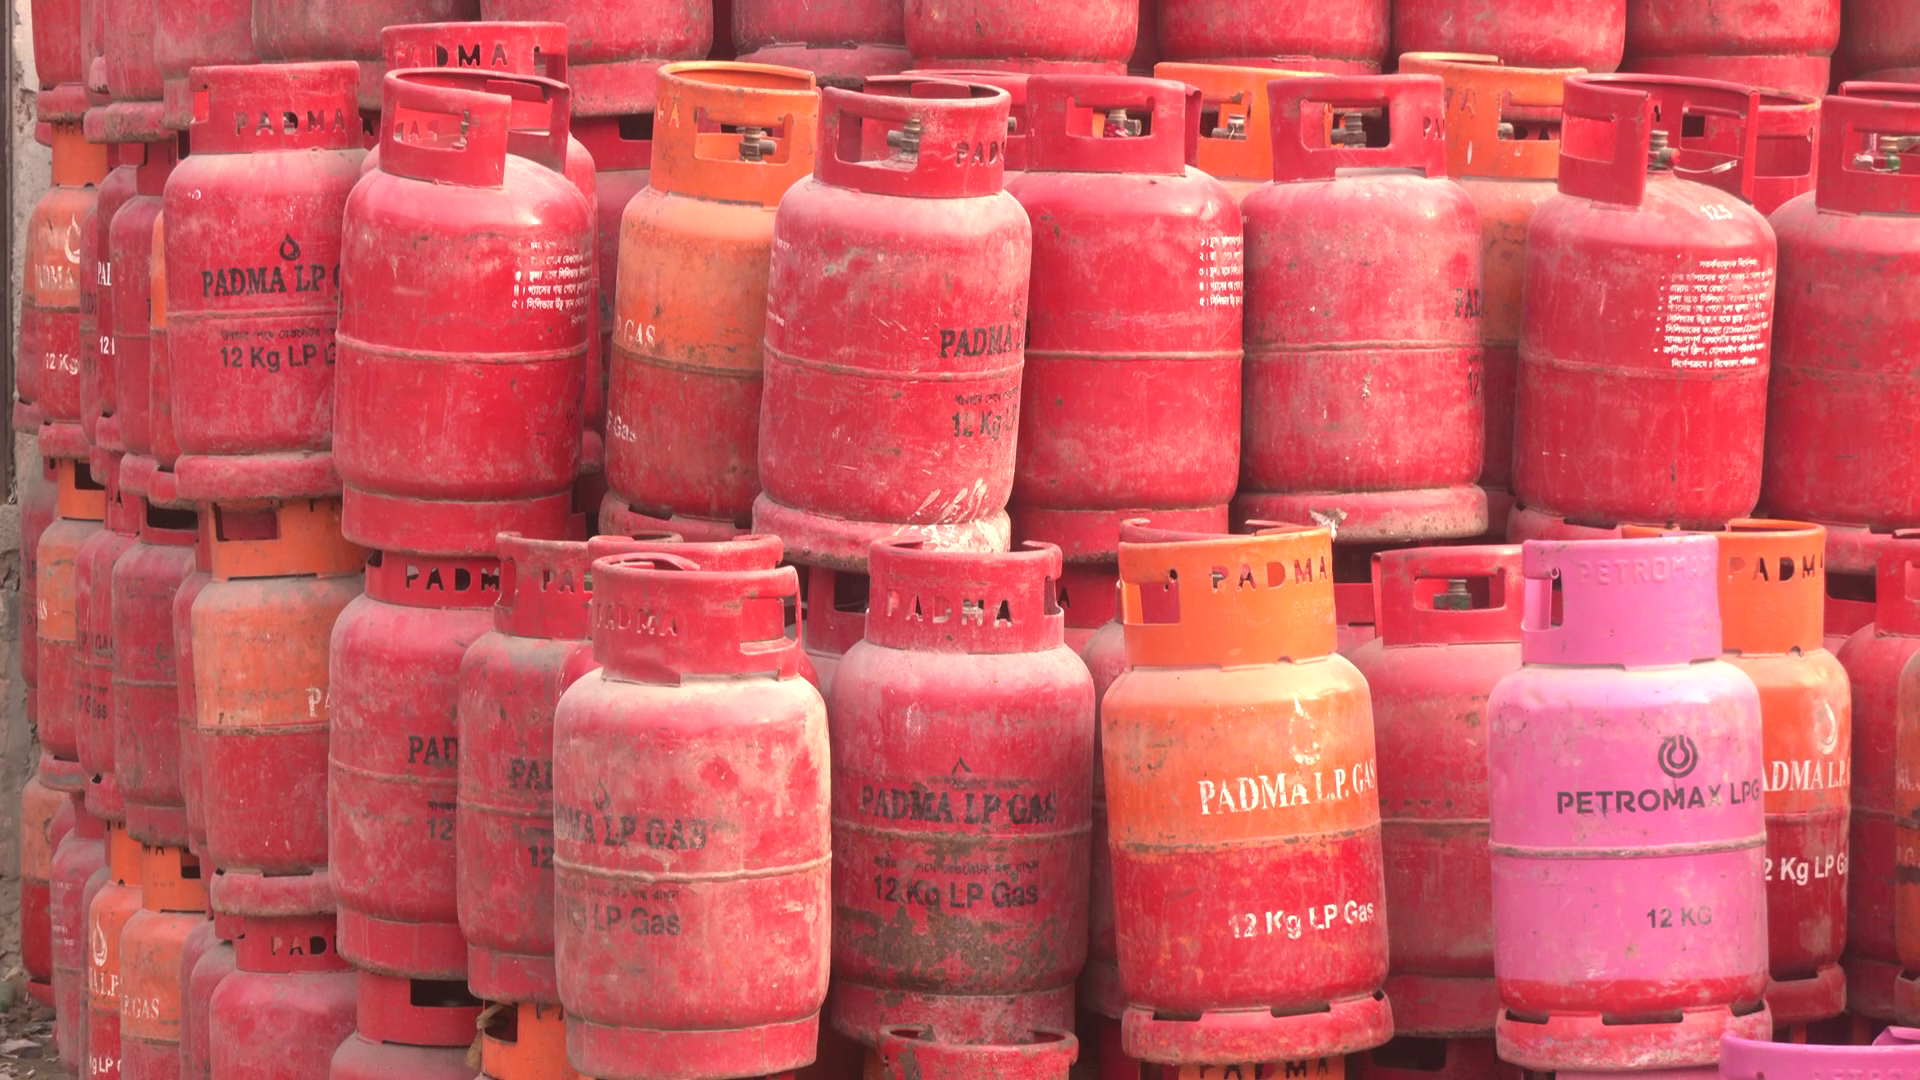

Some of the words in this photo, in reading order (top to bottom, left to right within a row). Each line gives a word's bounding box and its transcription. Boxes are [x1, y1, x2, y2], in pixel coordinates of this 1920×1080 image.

[233, 108, 346, 136] PADMA
[202, 266, 287, 297] PADMA
[295, 264, 326, 292] LP
[939, 325, 1012, 358] PADMA
[46, 352, 56, 370] 12
[220, 347, 243, 368] 12
[251, 346, 281, 373] Kg
[288, 344, 317, 367] LP
[1208, 555, 1329, 593] PADMA
[1728, 553, 1825, 585] PADM
[886, 590, 1012, 627] PADMA
[1197, 772, 1311, 815] PADMA
[1352, 757, 1376, 795] GAS
[1557, 784, 1721, 814] PETROMAX
[1730, 778, 1760, 806] LPG
[859, 784, 953, 824] PADMA
[964, 792, 1001, 825] LP
[427, 818, 455, 841] 12
[604, 812, 637, 847] LP
[528, 845, 556, 869] 12
[1780, 857, 1809, 886] Kg
[1814, 854, 1834, 879] LP
[874, 874, 898, 902] 12
[950, 883, 984, 909] LP
[991, 881, 1040, 909] Gas
[630, 906, 681, 936] Gas
[1228, 912, 1258, 939] 12
[1265, 909, 1302, 940] Kg
[1308, 903, 1338, 930] LP
[1343, 899, 1375, 925] Gas
[1647, 909, 1672, 929] 12
[1680, 906, 1713, 928] KG
[271, 935, 337, 956] PAD
